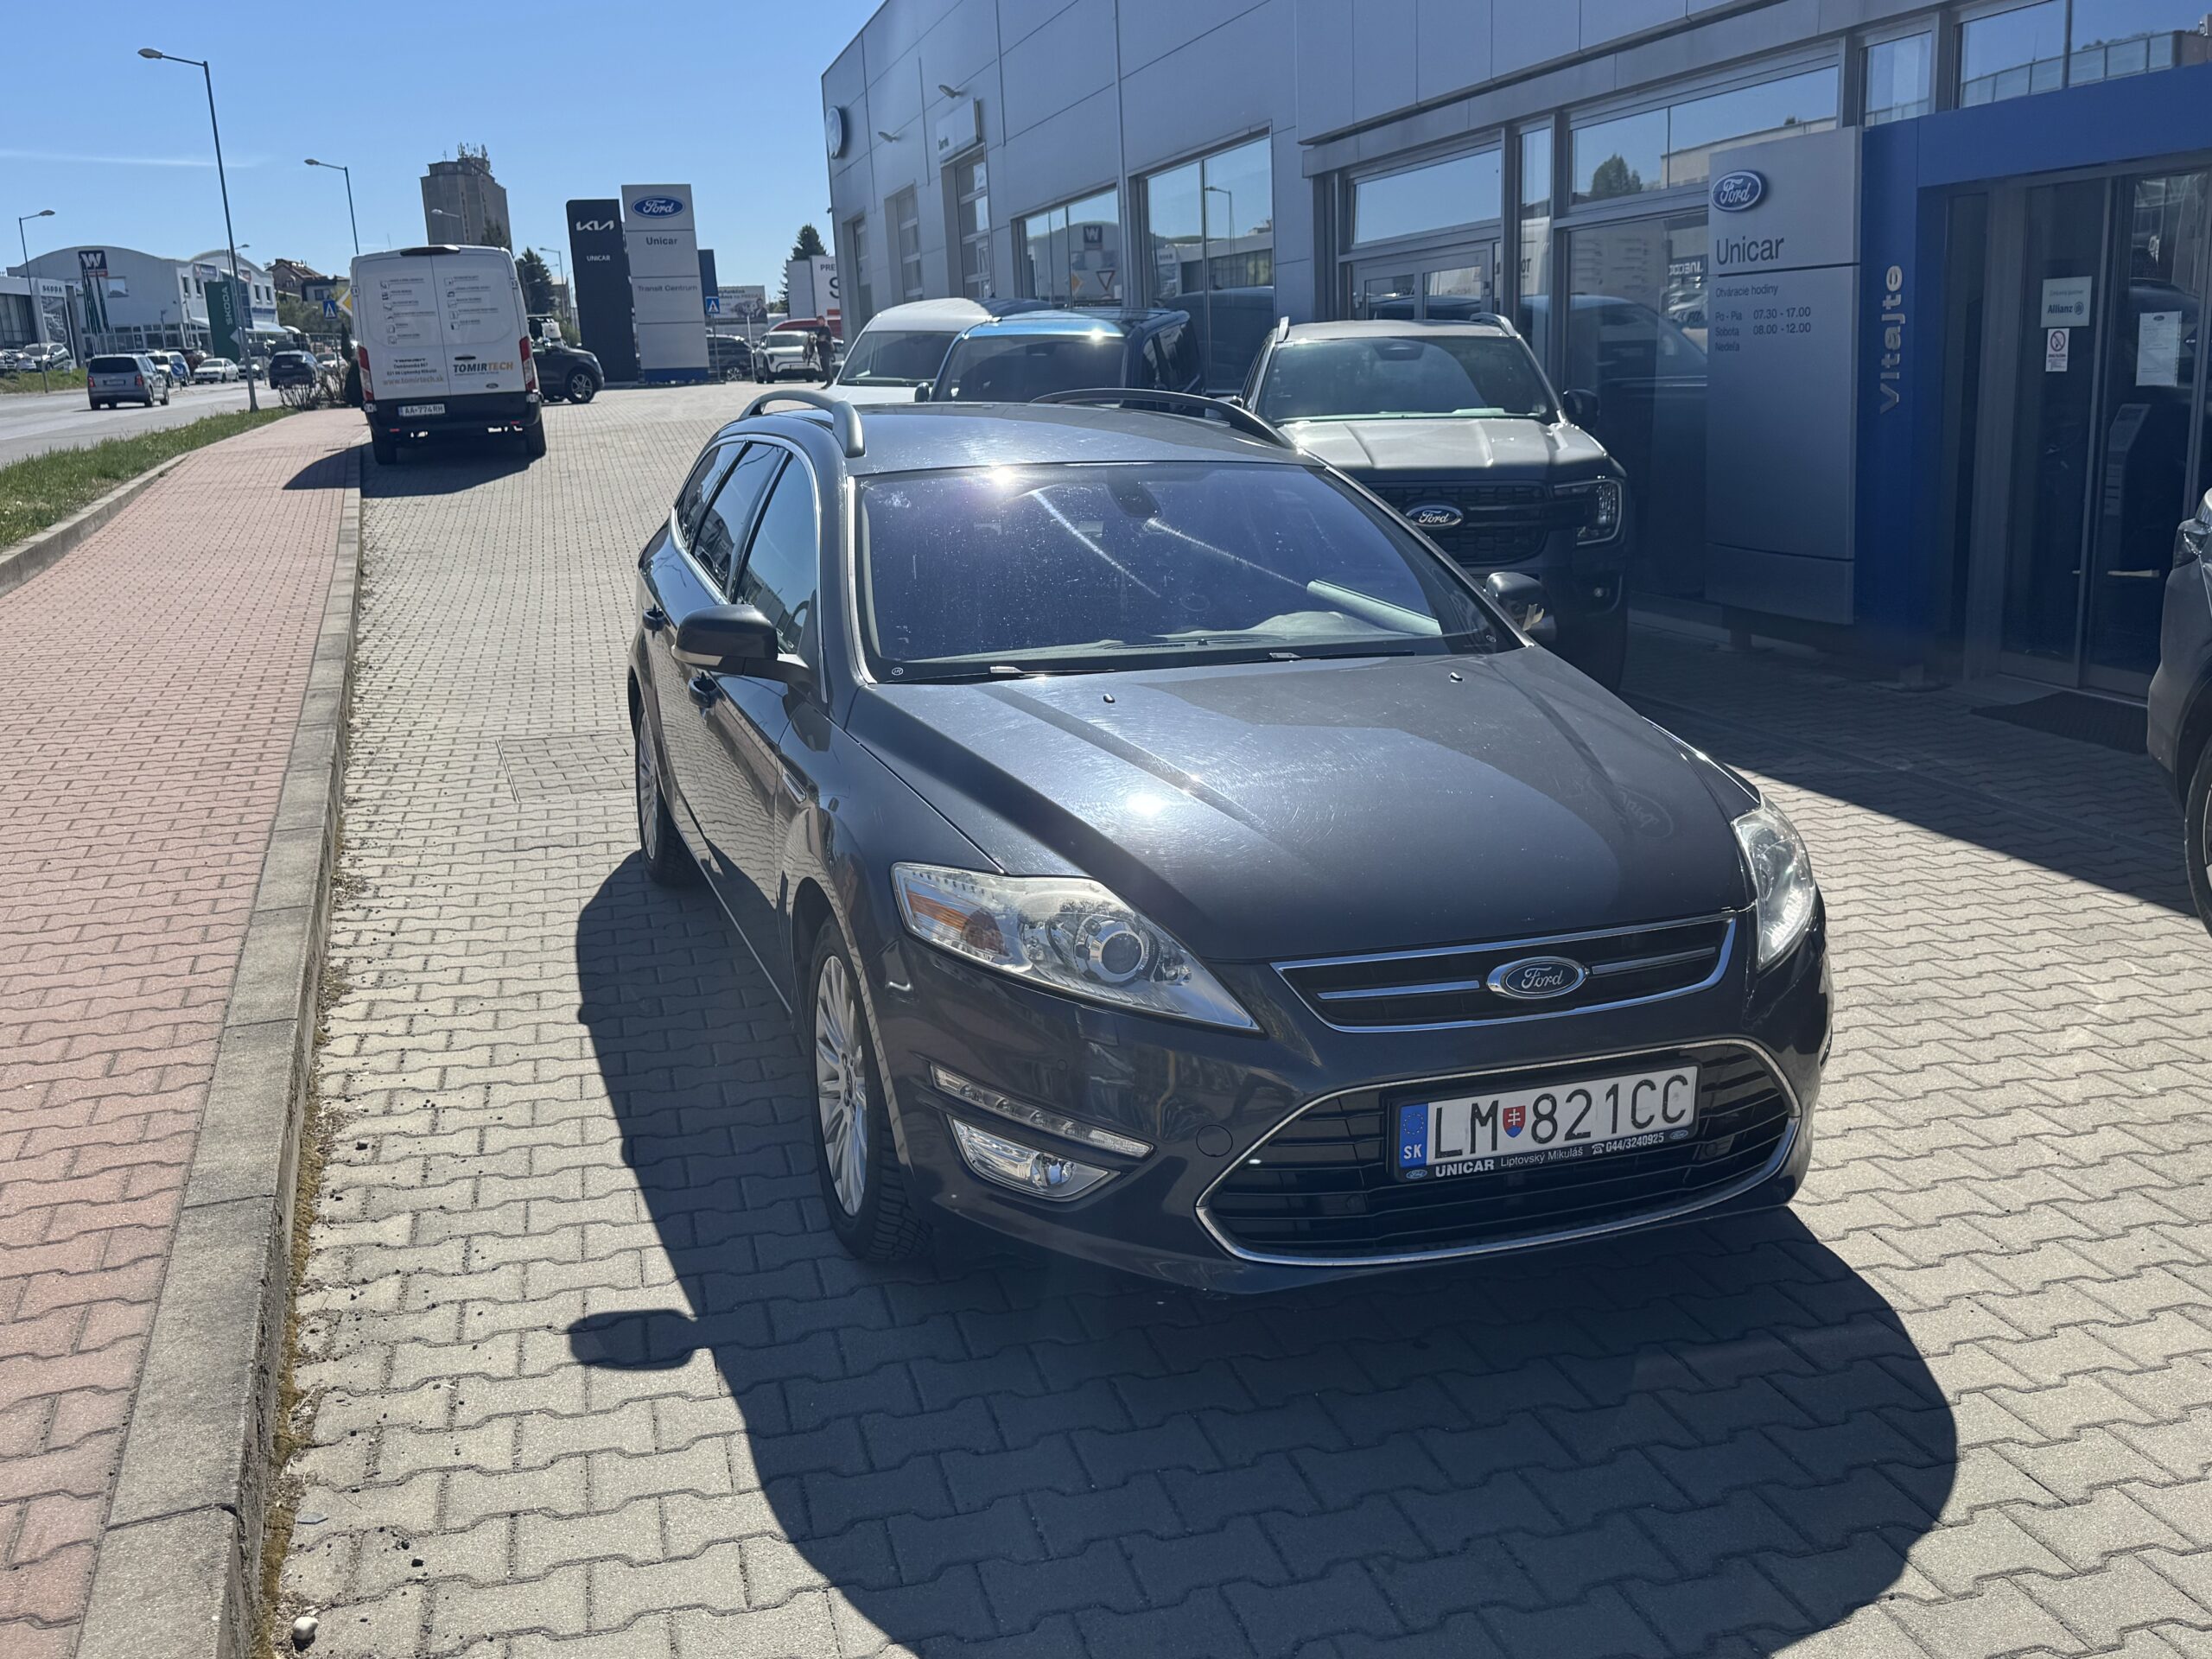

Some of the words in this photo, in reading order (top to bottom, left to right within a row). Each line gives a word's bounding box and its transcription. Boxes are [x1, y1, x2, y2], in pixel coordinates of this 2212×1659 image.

[1719, 177, 1752, 205] Ford
[642, 199, 675, 215] Ford
[575, 219, 614, 232] KIA
[645, 235, 678, 246] Unicar
[1716, 236, 1784, 265] Unicar
[664, 283, 698, 292] Centrum
[1751, 283, 1778, 296] hodiny
[1753, 308, 1777, 320] 07.30
[1786, 306, 1811, 318] 17.00
[2047, 303, 2074, 314] Allianz
[1753, 324, 1777, 335] 08.00
[1786, 321, 1811, 334] 12.00
[1879, 264, 1906, 415] Vitajte
[453, 361, 514, 373] TOMIRTECH
[1418, 508, 1449, 524] Ford
[1521, 966, 1564, 989] Ford
[1434, 1099, 1499, 1160] LM
[1530, 1074, 1689, 1145] 821CC
[1403, 1143, 1423, 1160] SK
[1434, 1159, 1495, 1178] UNICAR
[1500, 1151, 1545, 1167] Liptovský
[1548, 1147, 1584, 1161] Mikuláš
[1605, 1132, 1665, 1153] 044/3240925
